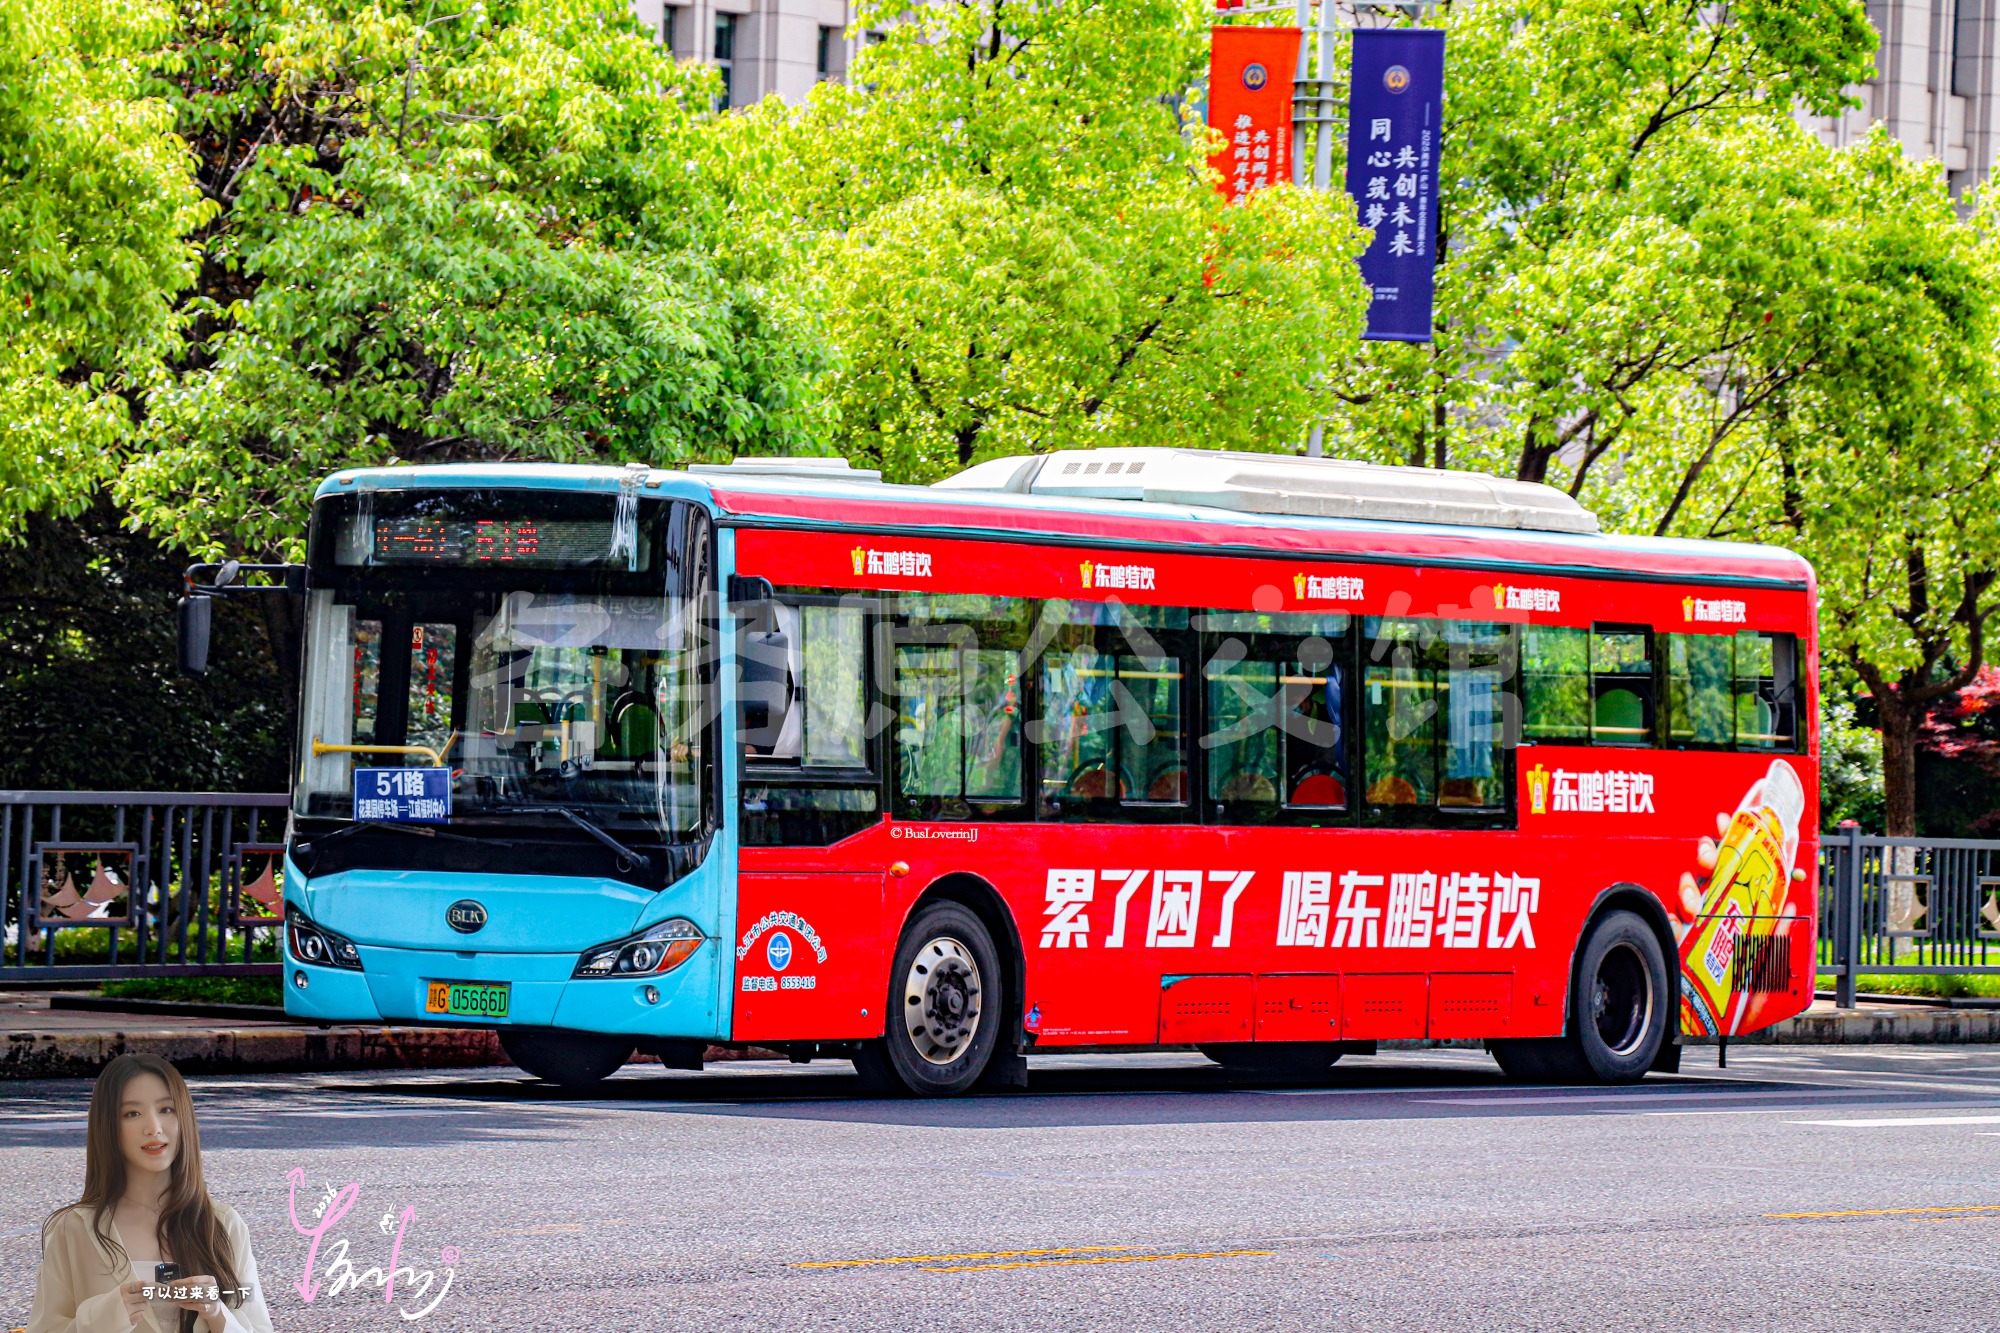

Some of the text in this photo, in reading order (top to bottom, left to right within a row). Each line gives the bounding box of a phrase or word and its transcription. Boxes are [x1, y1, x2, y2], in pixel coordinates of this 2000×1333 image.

[1365, 118, 1392, 229] 同心筑梦
[1388, 144, 1420, 257] 共创未来
[867, 549, 932, 577] 东鹏特饮
[1095, 563, 1155, 590] 东鹏特饮
[1307, 575, 1364, 600] 东鹏特饮
[1506, 586, 1560, 612] 东鹏特饮
[1694, 598, 1746, 623] 东鹏特饮
[376, 771, 425, 797] 51路
[1552, 768, 1655, 813] 东鹏特饮
[451, 909, 484, 924] BLK
[1039, 869, 1540, 949] 累了困了 喝东鹏特饮
[737, 910, 827, 963] 九江市公共交通集团公司
